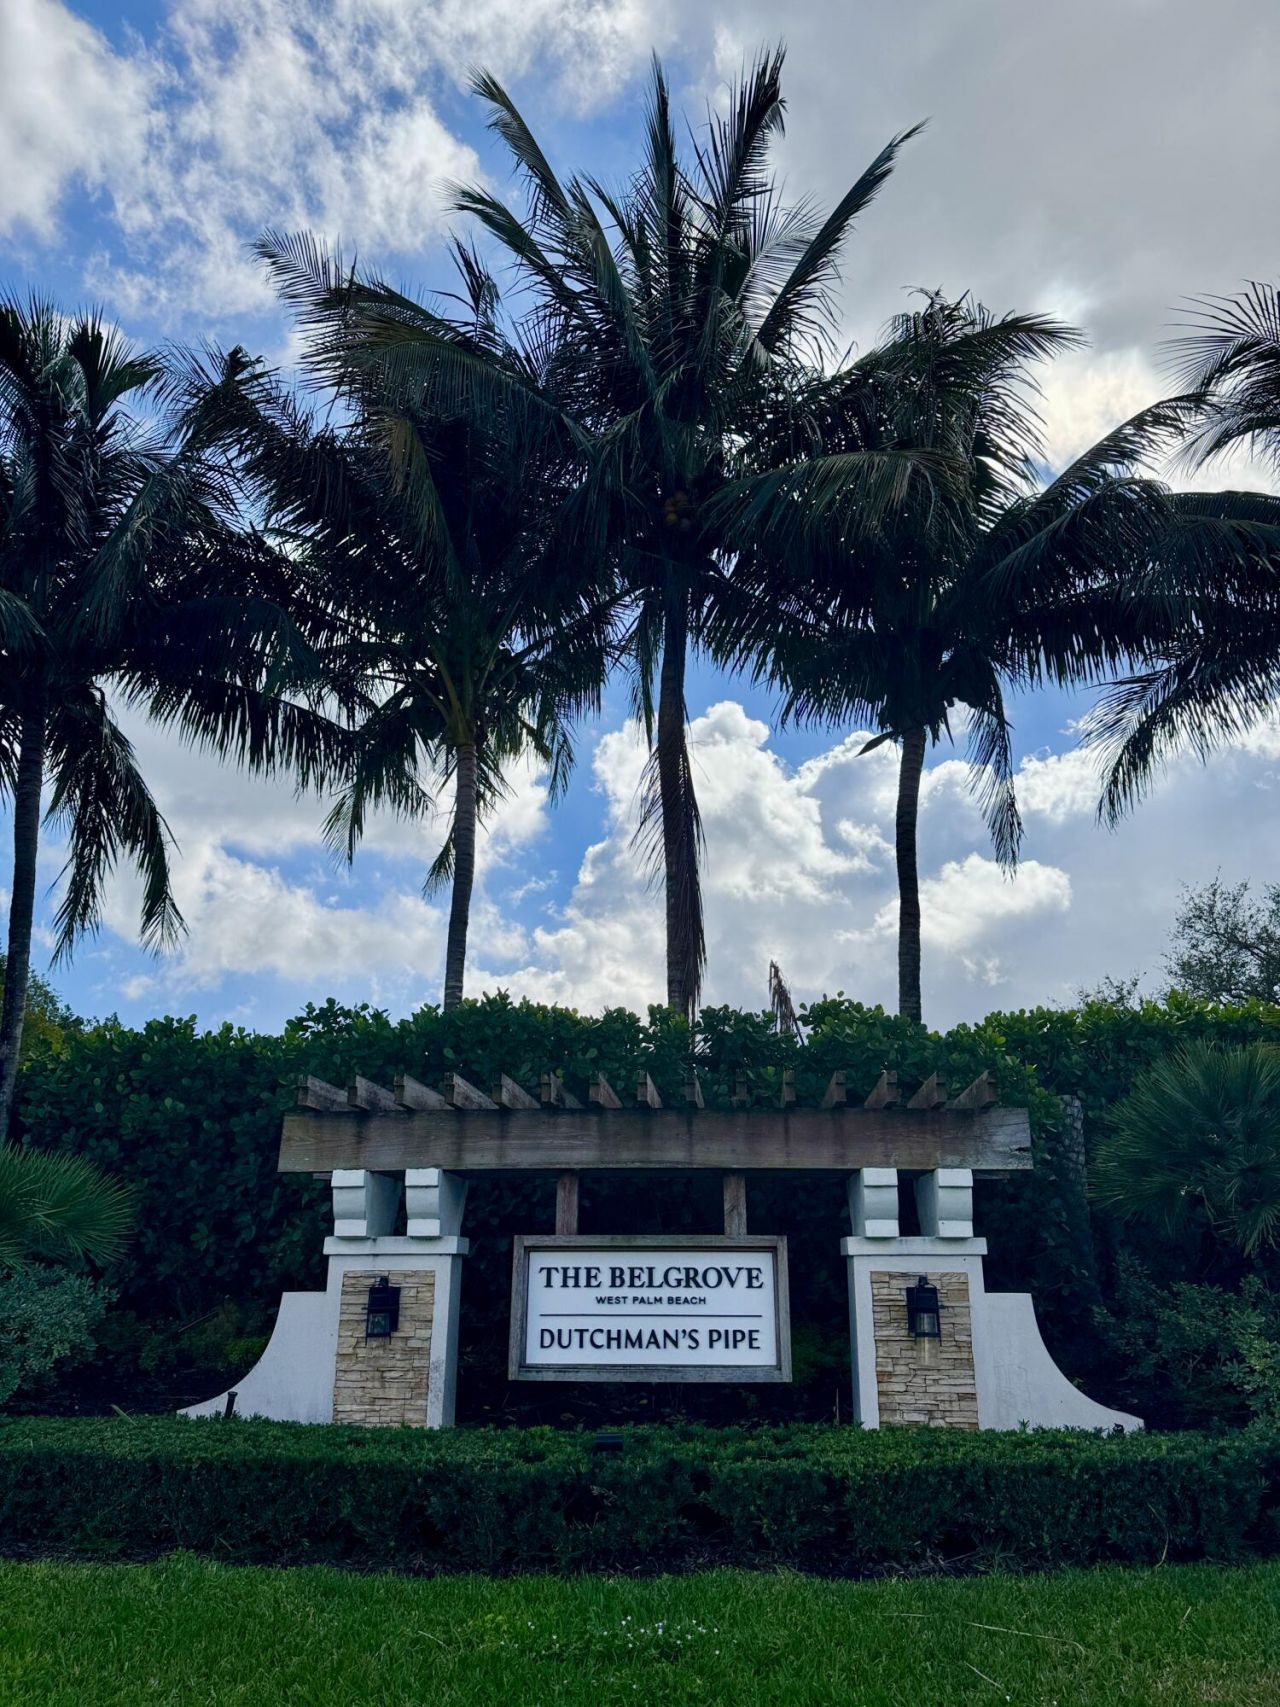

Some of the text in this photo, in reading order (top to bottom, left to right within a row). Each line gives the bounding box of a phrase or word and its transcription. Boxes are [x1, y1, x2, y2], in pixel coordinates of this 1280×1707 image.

[539, 1267, 764, 1289] THE BELGROVE
[595, 1296, 706, 1305] WEST PALM BEACH
[540, 1328, 761, 1349] DUTCHMAN'S PIPE
